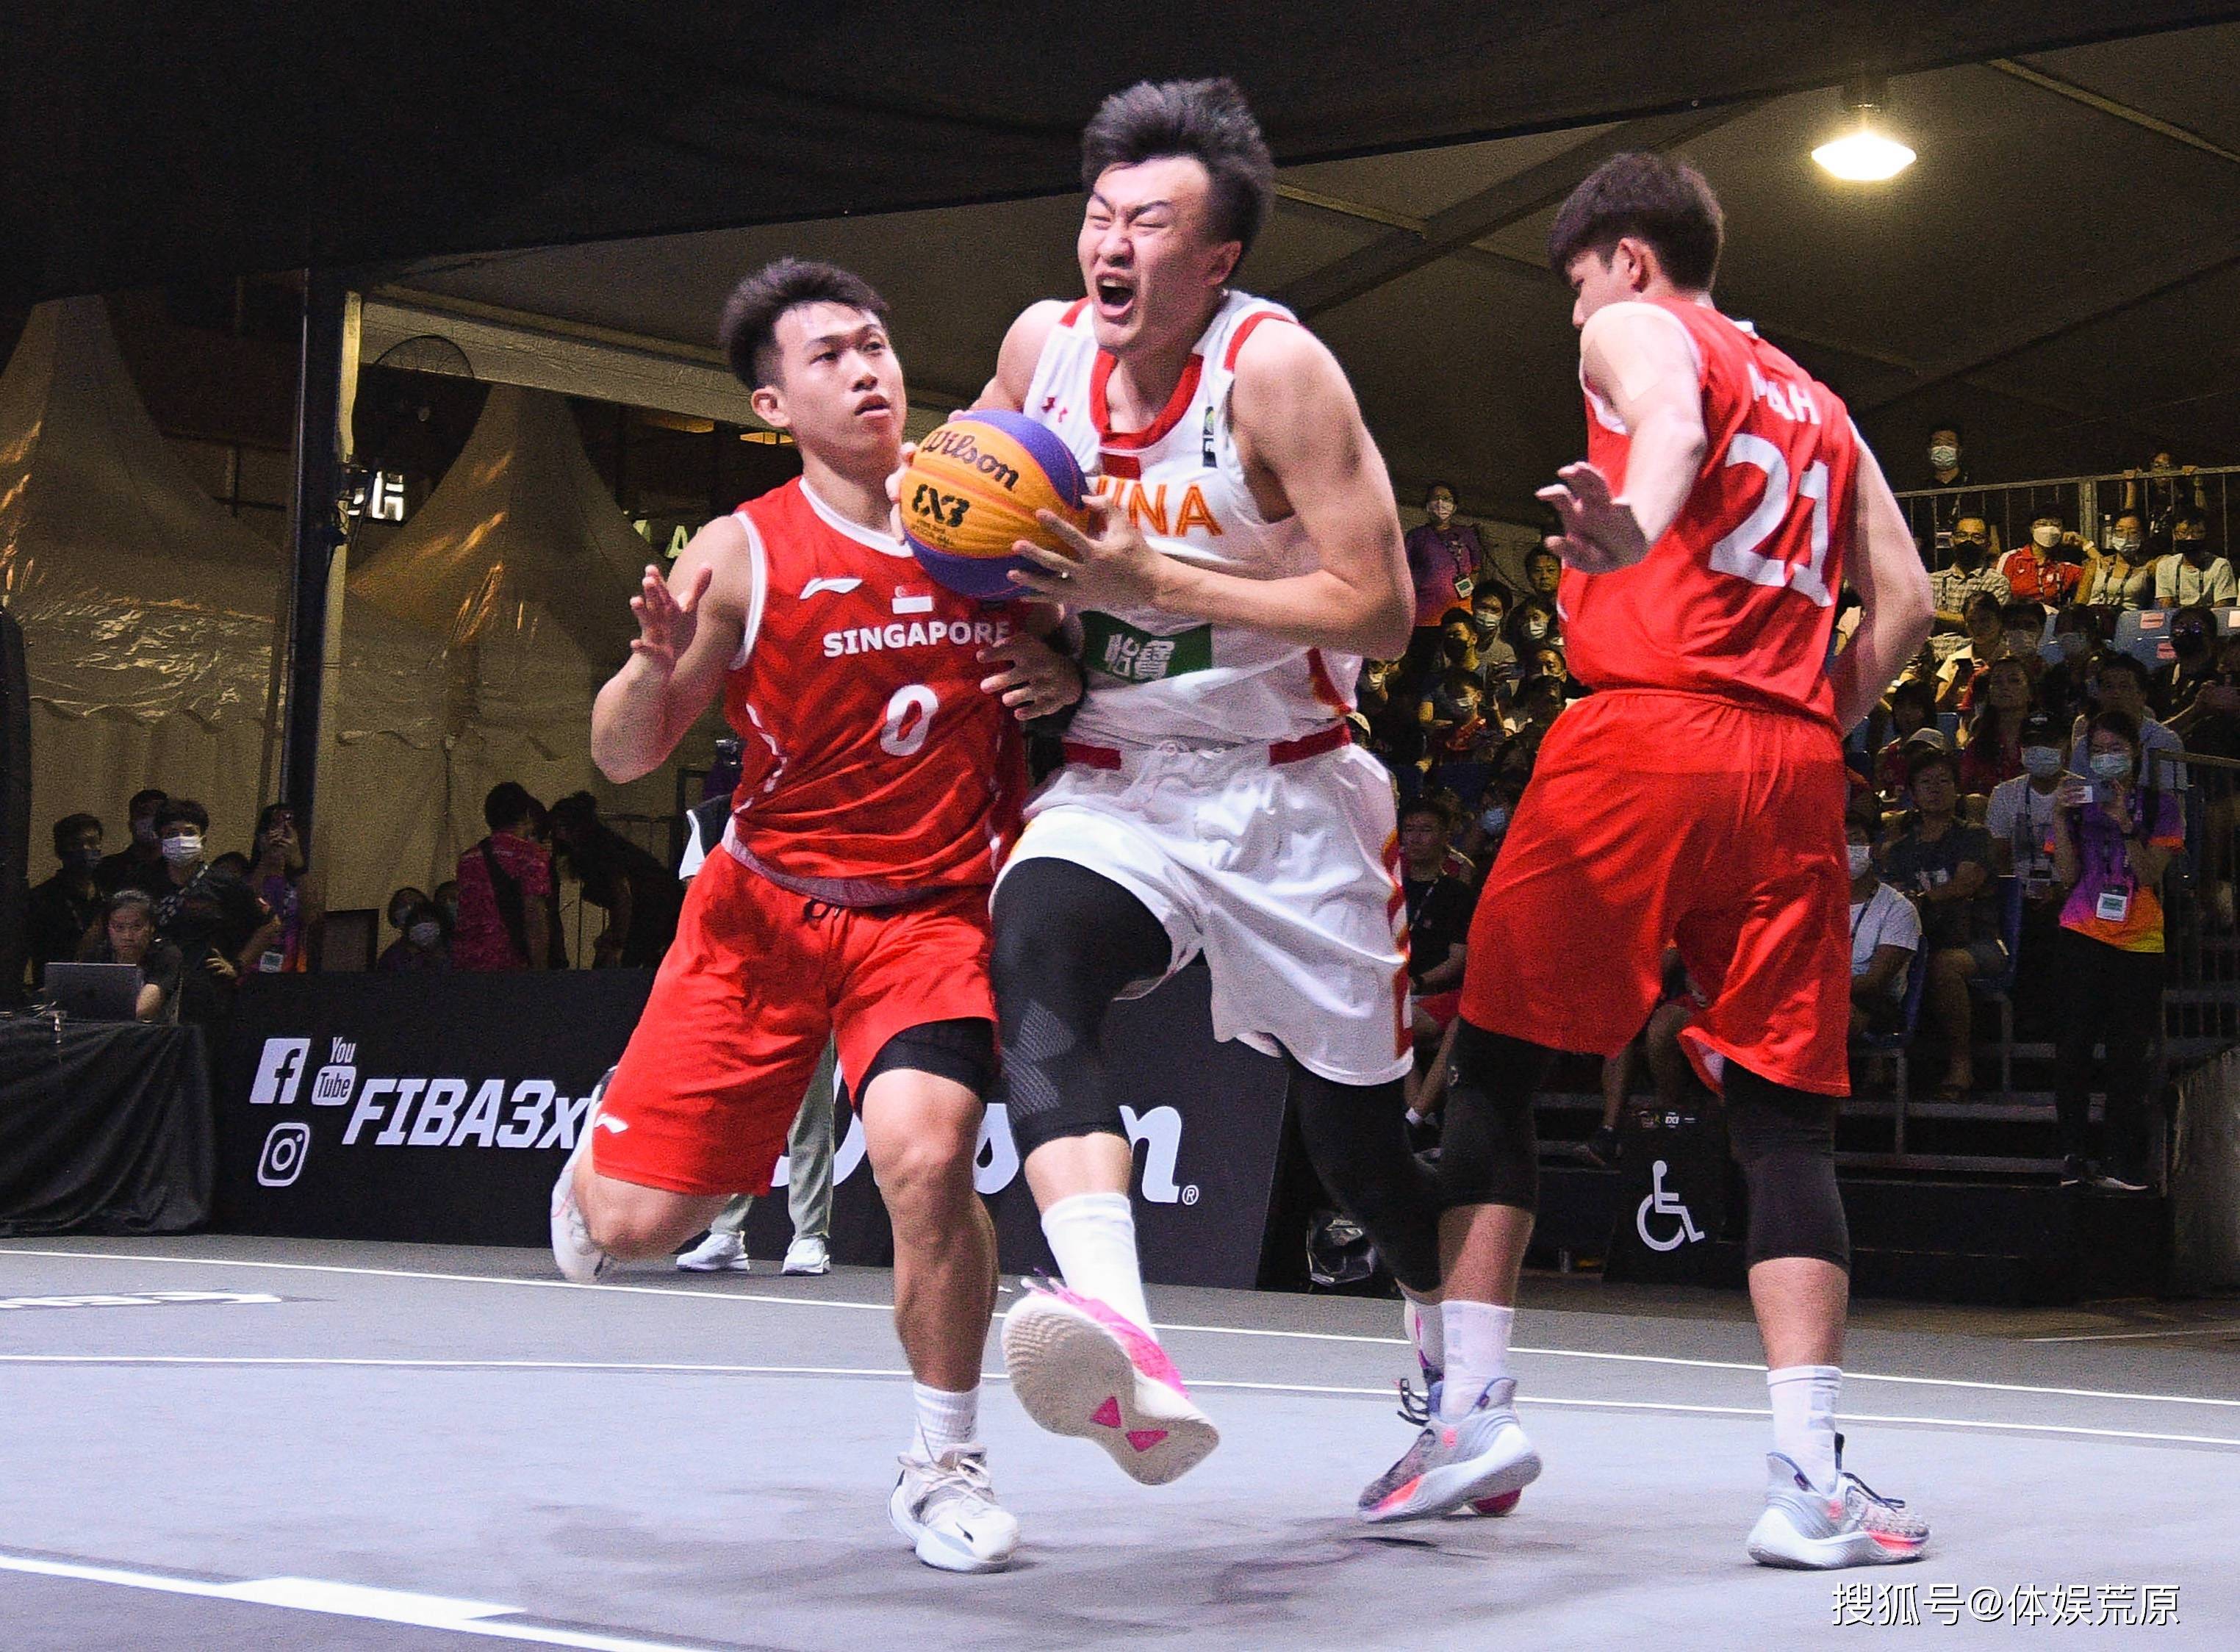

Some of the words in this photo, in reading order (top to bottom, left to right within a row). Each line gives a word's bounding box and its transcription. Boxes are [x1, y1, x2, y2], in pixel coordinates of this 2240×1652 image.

[922, 431, 1019, 492] Wilson
[1096, 475, 1224, 537] INA
[1708, 433, 1834, 607] 21
[822, 622, 1011, 658] SINGAPORE
[880, 684, 939, 757] 0
[329, 1037, 356, 1063] You
[316, 1072, 351, 1099] Tube
